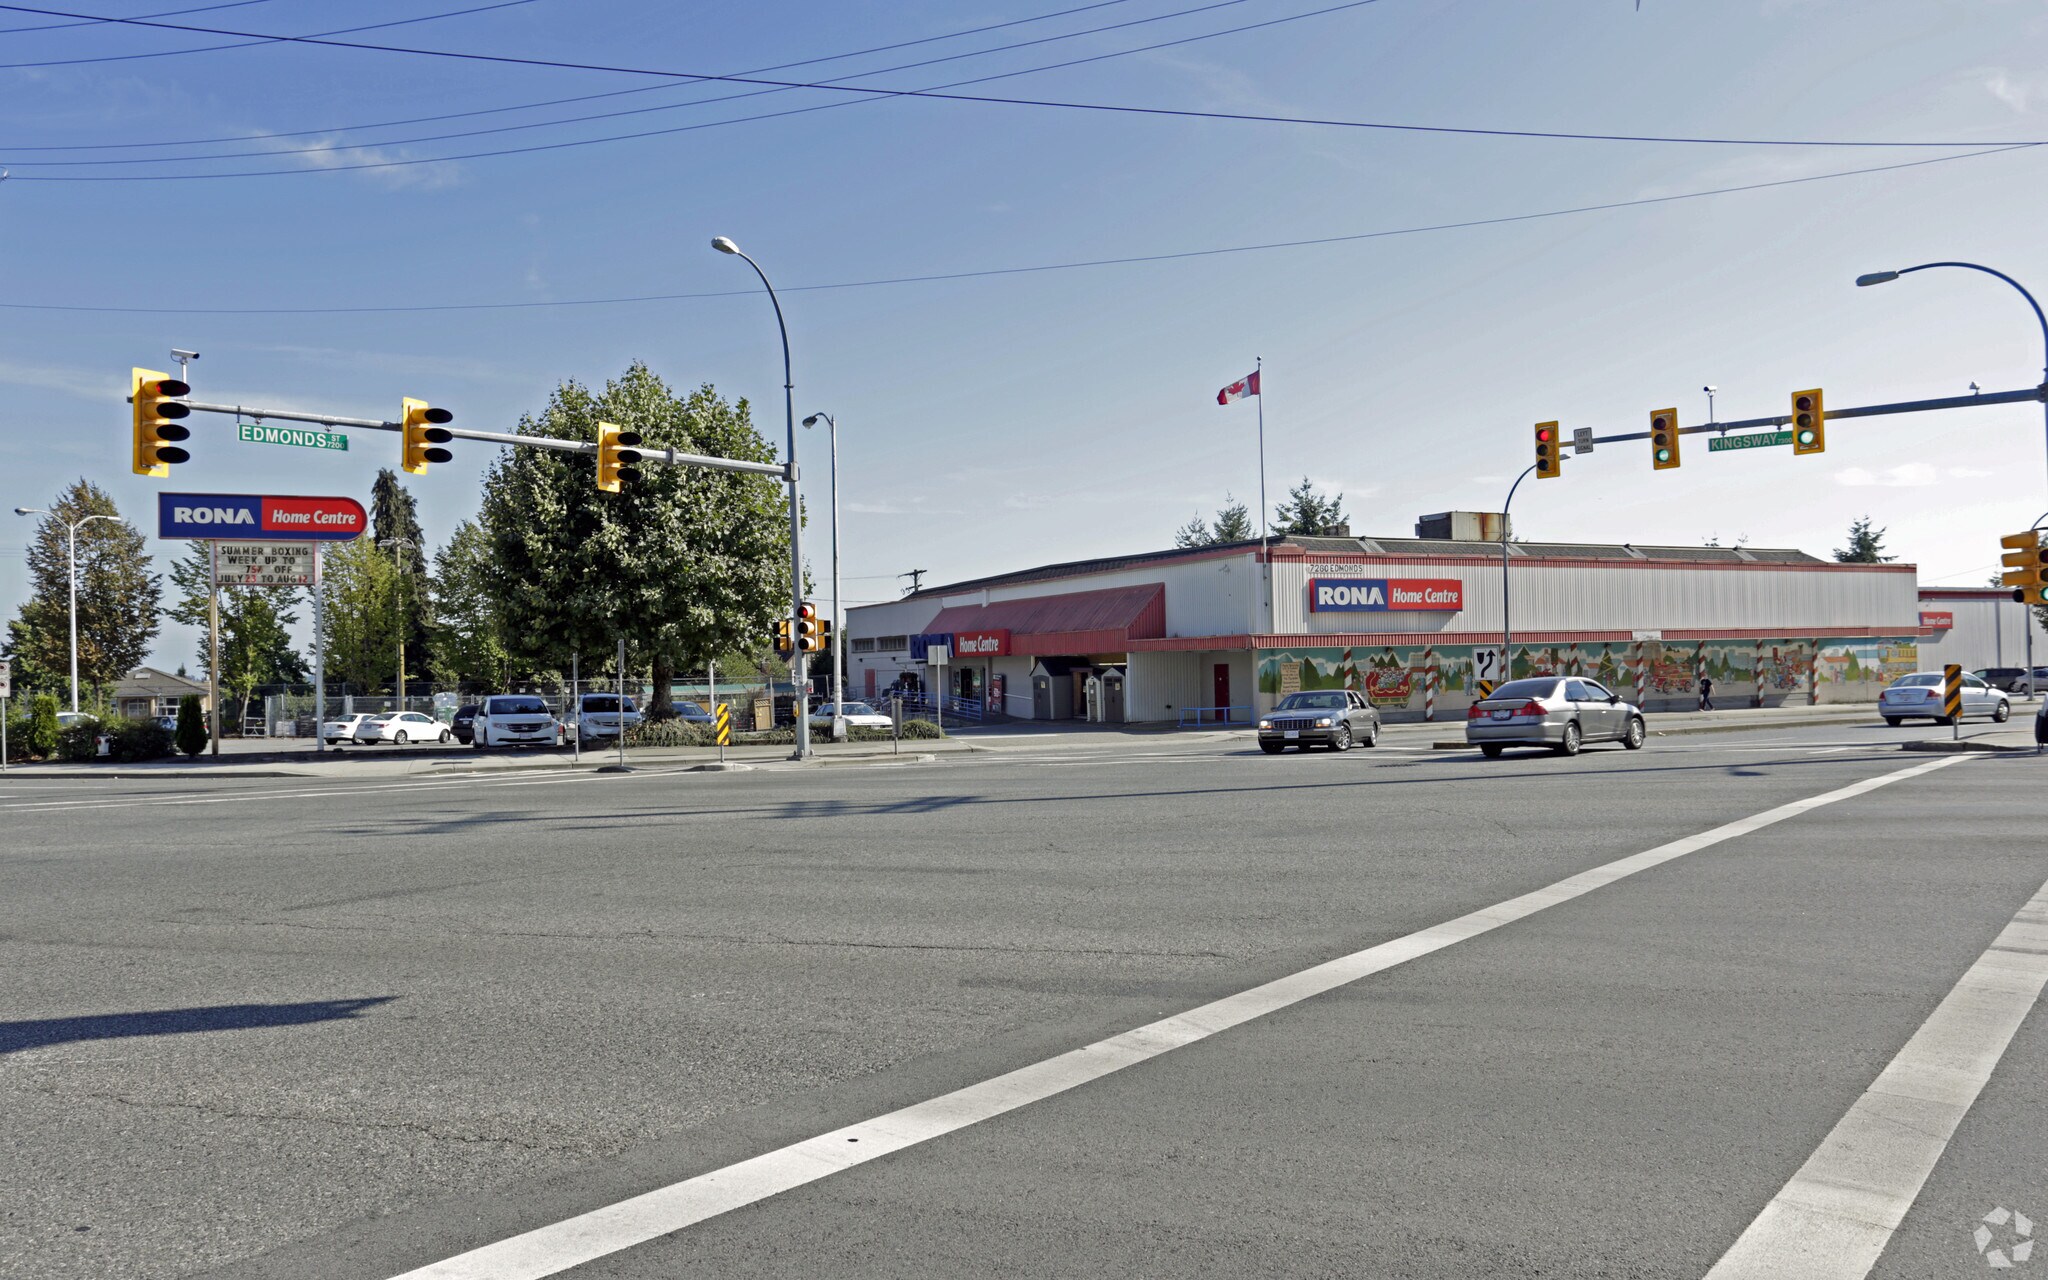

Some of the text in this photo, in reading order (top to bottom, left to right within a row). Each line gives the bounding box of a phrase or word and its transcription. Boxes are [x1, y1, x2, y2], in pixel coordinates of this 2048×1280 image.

[241, 426, 327, 448] EDMONDS
[331, 434, 341, 442] ST
[1711, 433, 1778, 451] KINGSWAY
[327, 441, 345, 449] 7200
[174, 507, 255, 525] RONA
[272, 509, 356, 525] Home Centre
[221, 546, 308, 556] SUMMER BOXING
[228, 556, 296, 565] WEEK UP TO
[274, 565, 292, 574] OFF
[1330, 564, 1363, 573] EDMONDS
[218, 574, 308, 583] JULY 23 TO AUG 12
[1318, 586, 1385, 606] RONA
[1392, 587, 1458, 604] Home Centre
[959, 635, 999, 653] Home Centre
